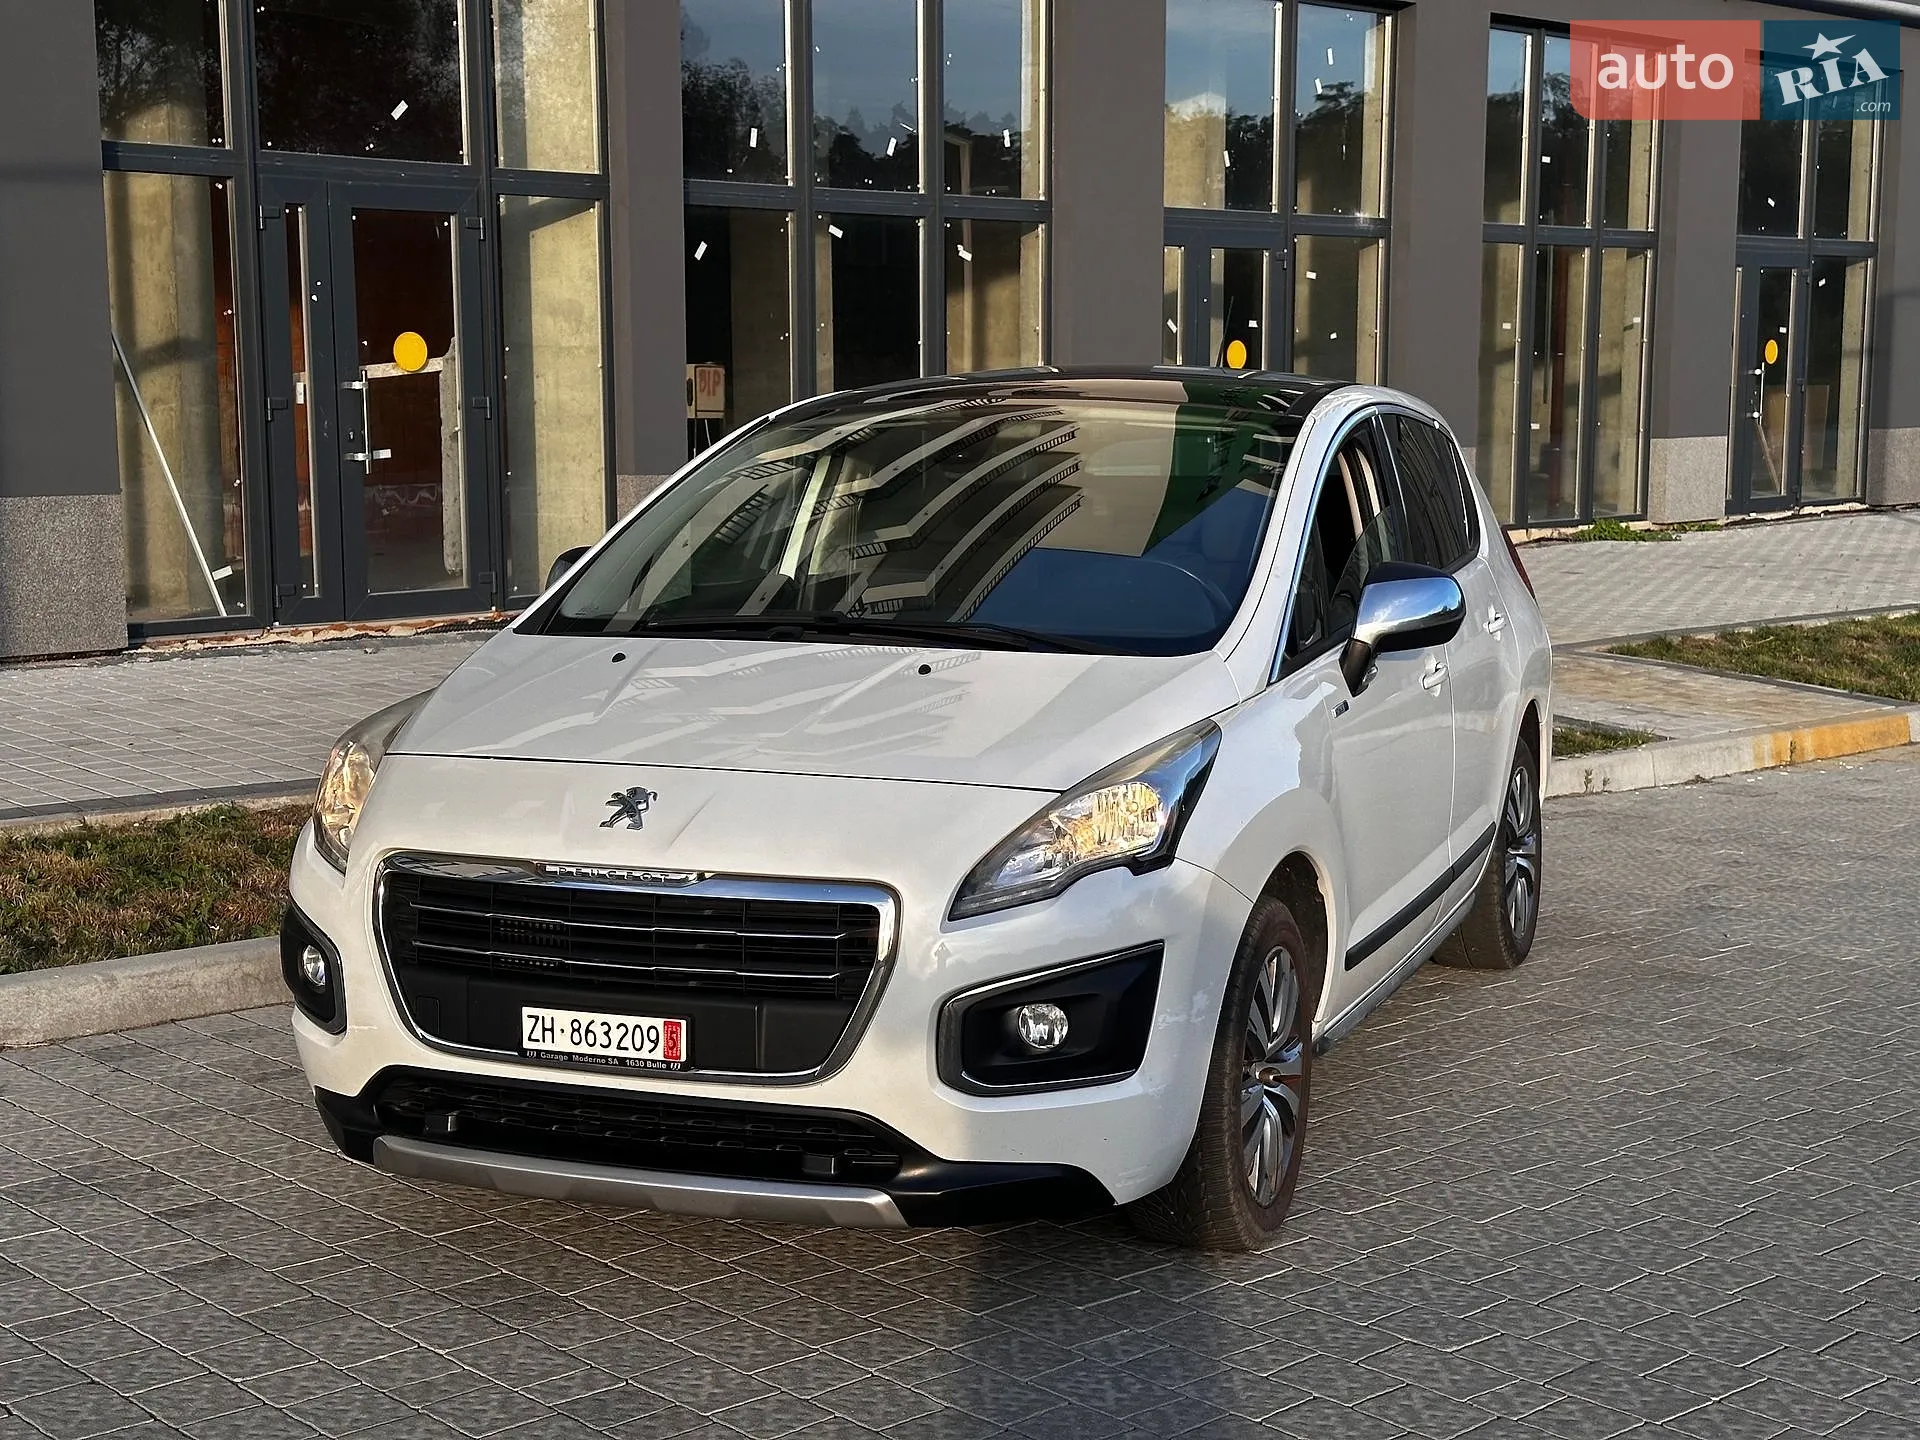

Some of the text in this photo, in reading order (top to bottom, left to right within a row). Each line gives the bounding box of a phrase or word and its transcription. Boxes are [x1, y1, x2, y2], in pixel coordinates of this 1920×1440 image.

[556, 866, 670, 883] PEUGEOT
[540, 1051, 569, 1061] Garage
[607, 1057, 619, 1065] SA
[625, 1059, 645, 1068] 1630
[646, 1060, 667, 1069] Bulle
